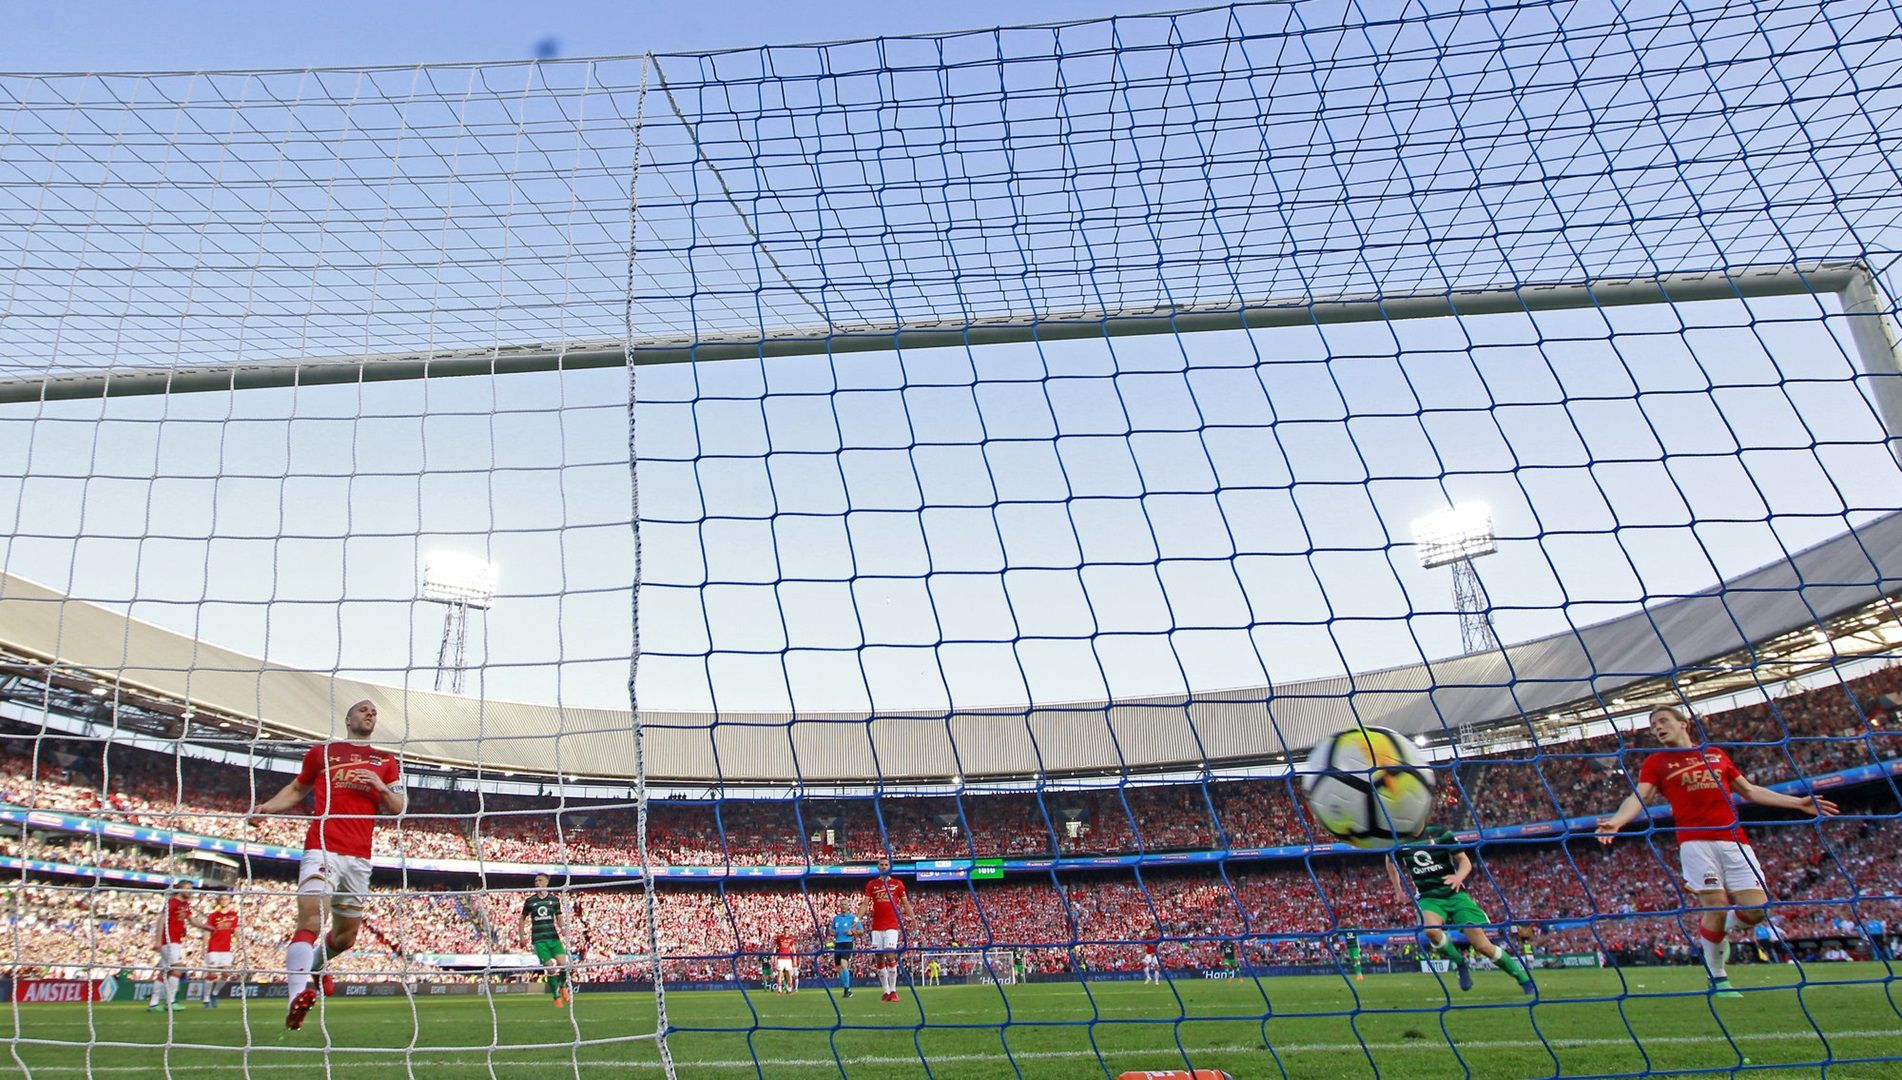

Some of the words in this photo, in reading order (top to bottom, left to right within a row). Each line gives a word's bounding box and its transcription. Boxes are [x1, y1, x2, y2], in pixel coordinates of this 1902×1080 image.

[1413, 850, 1434, 867] Q
[537, 905, 548, 917] Q
[23, 982, 82, 1002] AMSTEL
